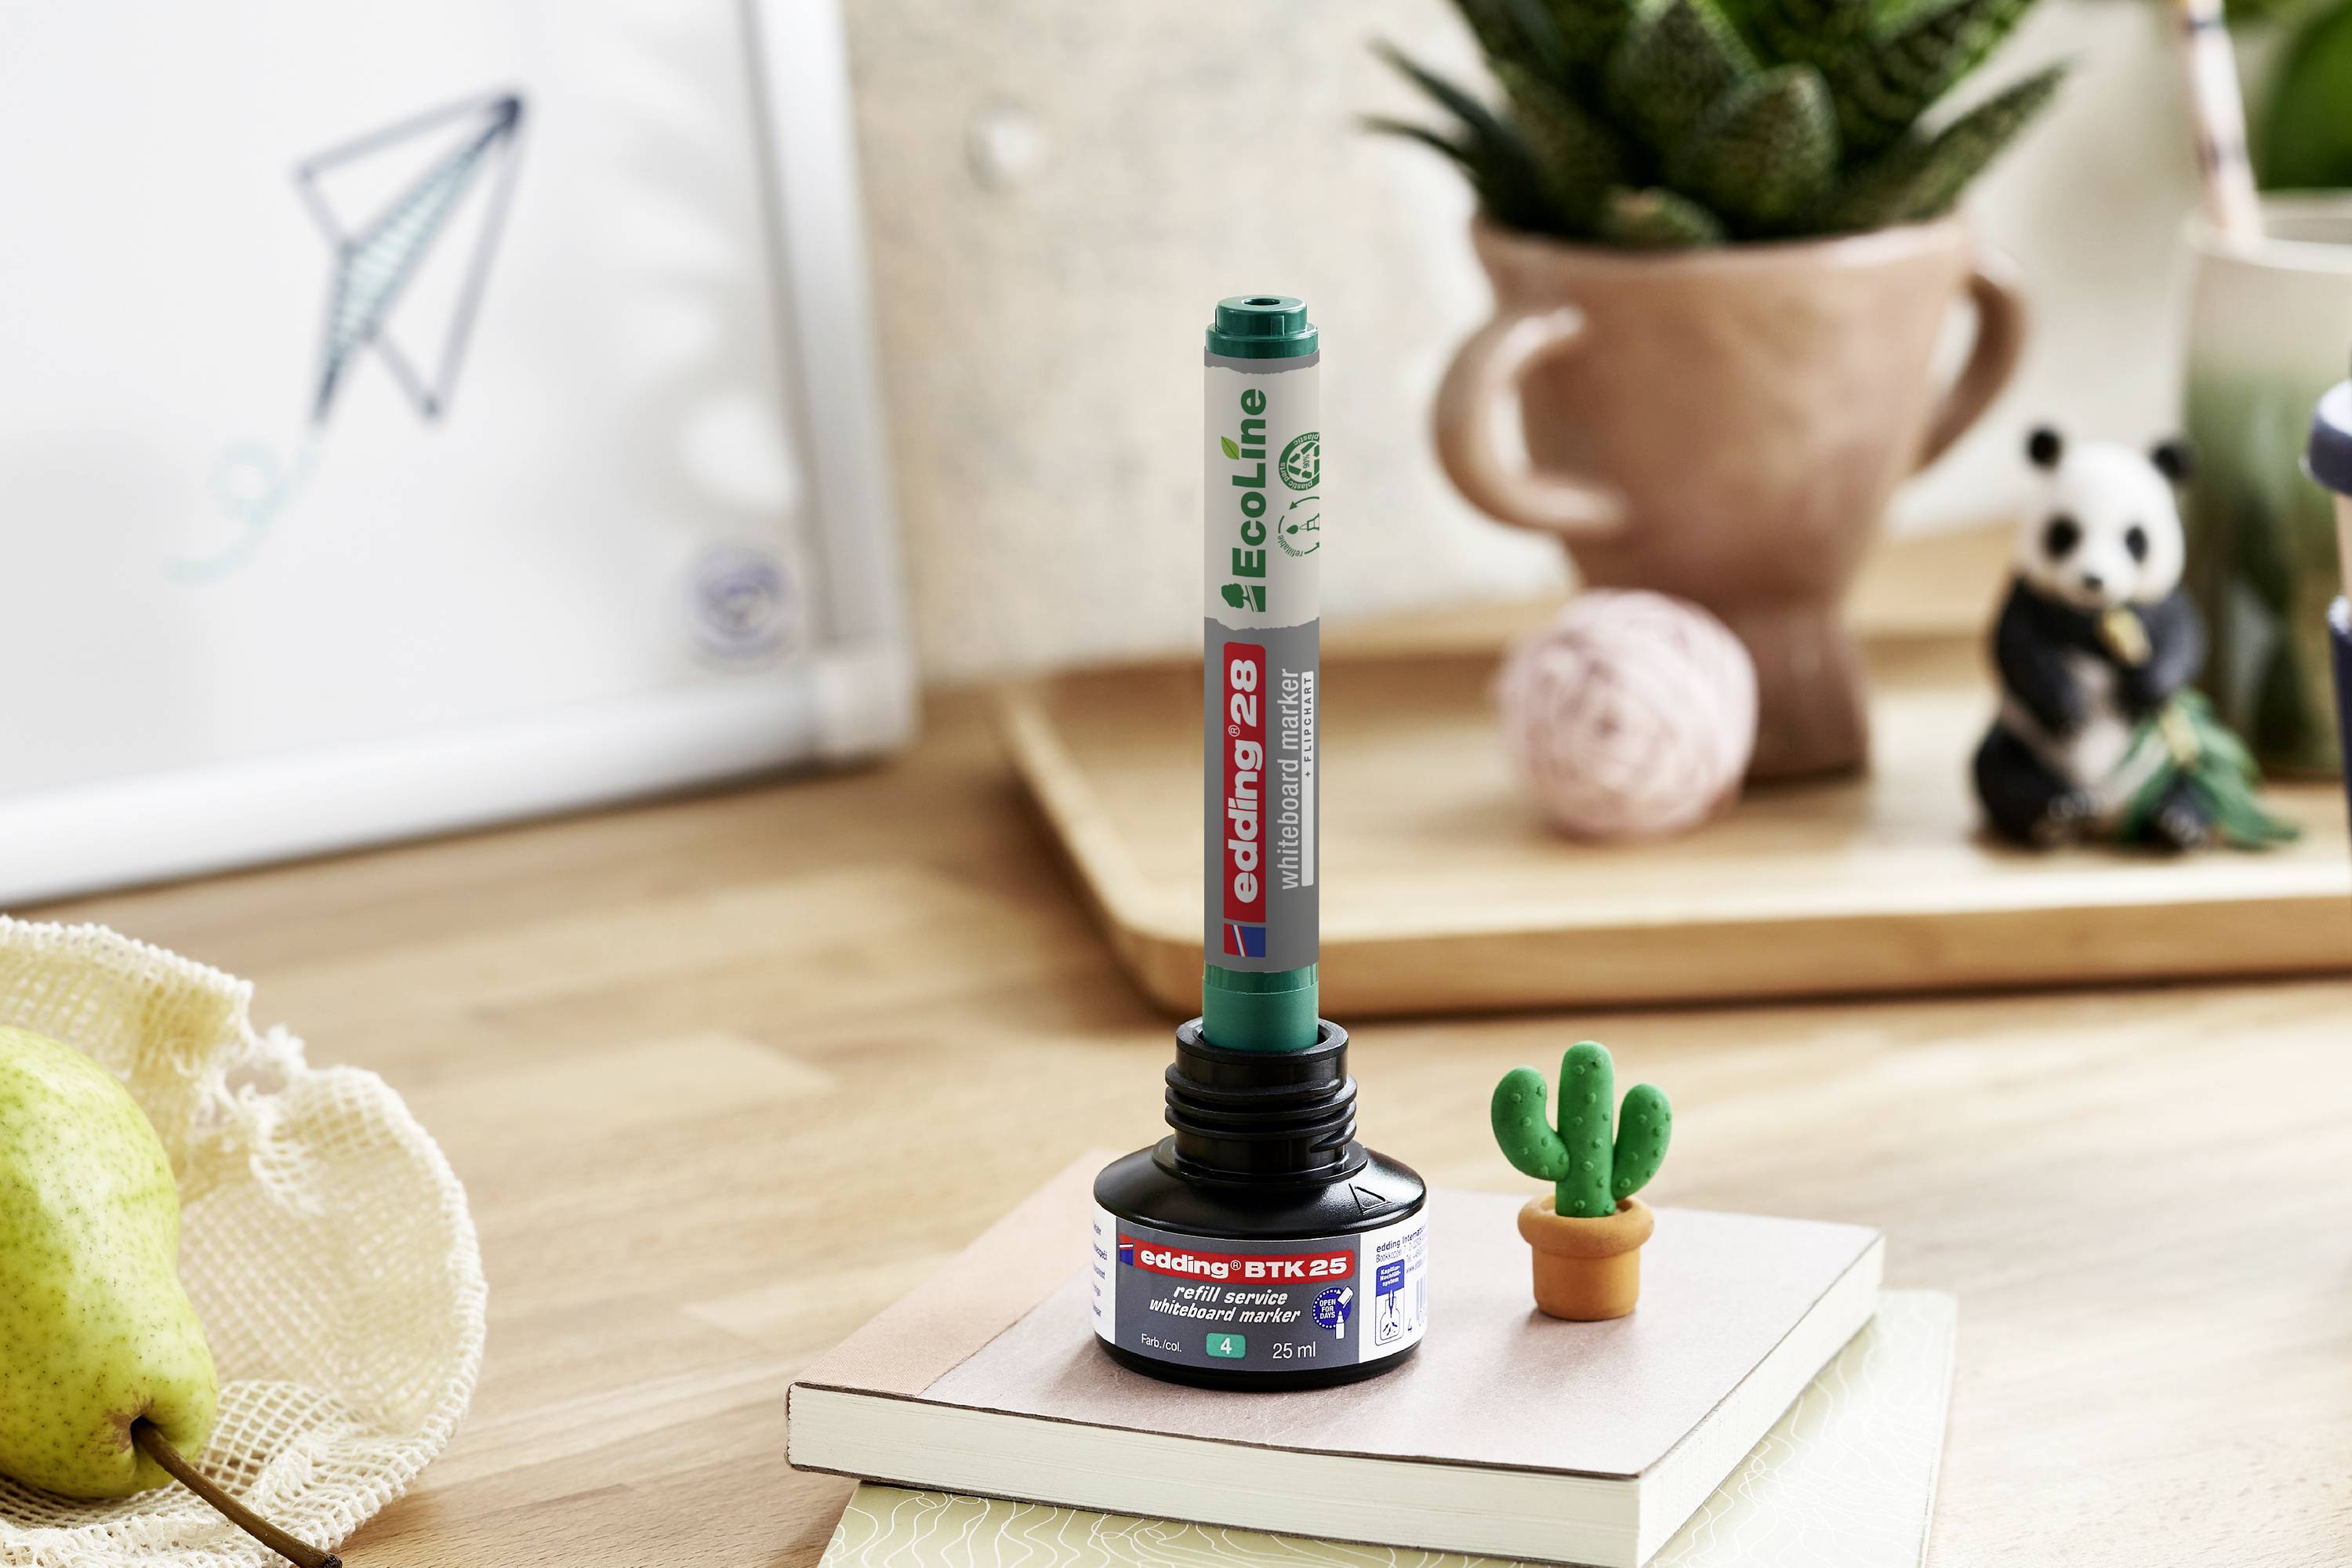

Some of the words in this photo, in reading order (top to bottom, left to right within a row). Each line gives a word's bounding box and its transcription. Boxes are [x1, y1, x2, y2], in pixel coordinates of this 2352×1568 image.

[1279, 462, 1291, 481] parts
[1232, 388, 1266, 578] EcoLine
[1288, 479, 1313, 490] plastic
[1277, 534, 1304, 557] refillable
[1230, 659, 1258, 728] 28
[1277, 668, 1299, 750] marker
[1303, 677, 1312, 762] FLIPCHART
[1277, 759, 1299, 890] whiteboard
[1376, 1240, 1400, 1253] edding
[1244, 1261, 1305, 1278] BTK
[1309, 1257, 1348, 1277] 25
[1174, 1286, 1221, 1302] refill
[1224, 1289, 1288, 1305] service
[1319, 1298, 1336, 1307] OPEN
[1149, 1298, 1236, 1322] whiteboard
[1239, 1308, 1301, 1323] marker
[1319, 1311, 1336, 1319] DAYS
[1141, 1333, 1182, 1352] Farb./col.
[1220, 1336, 1232, 1355] 4
[1272, 1342, 1293, 1359] 25
[1298, 1341, 1316, 1358] ml
